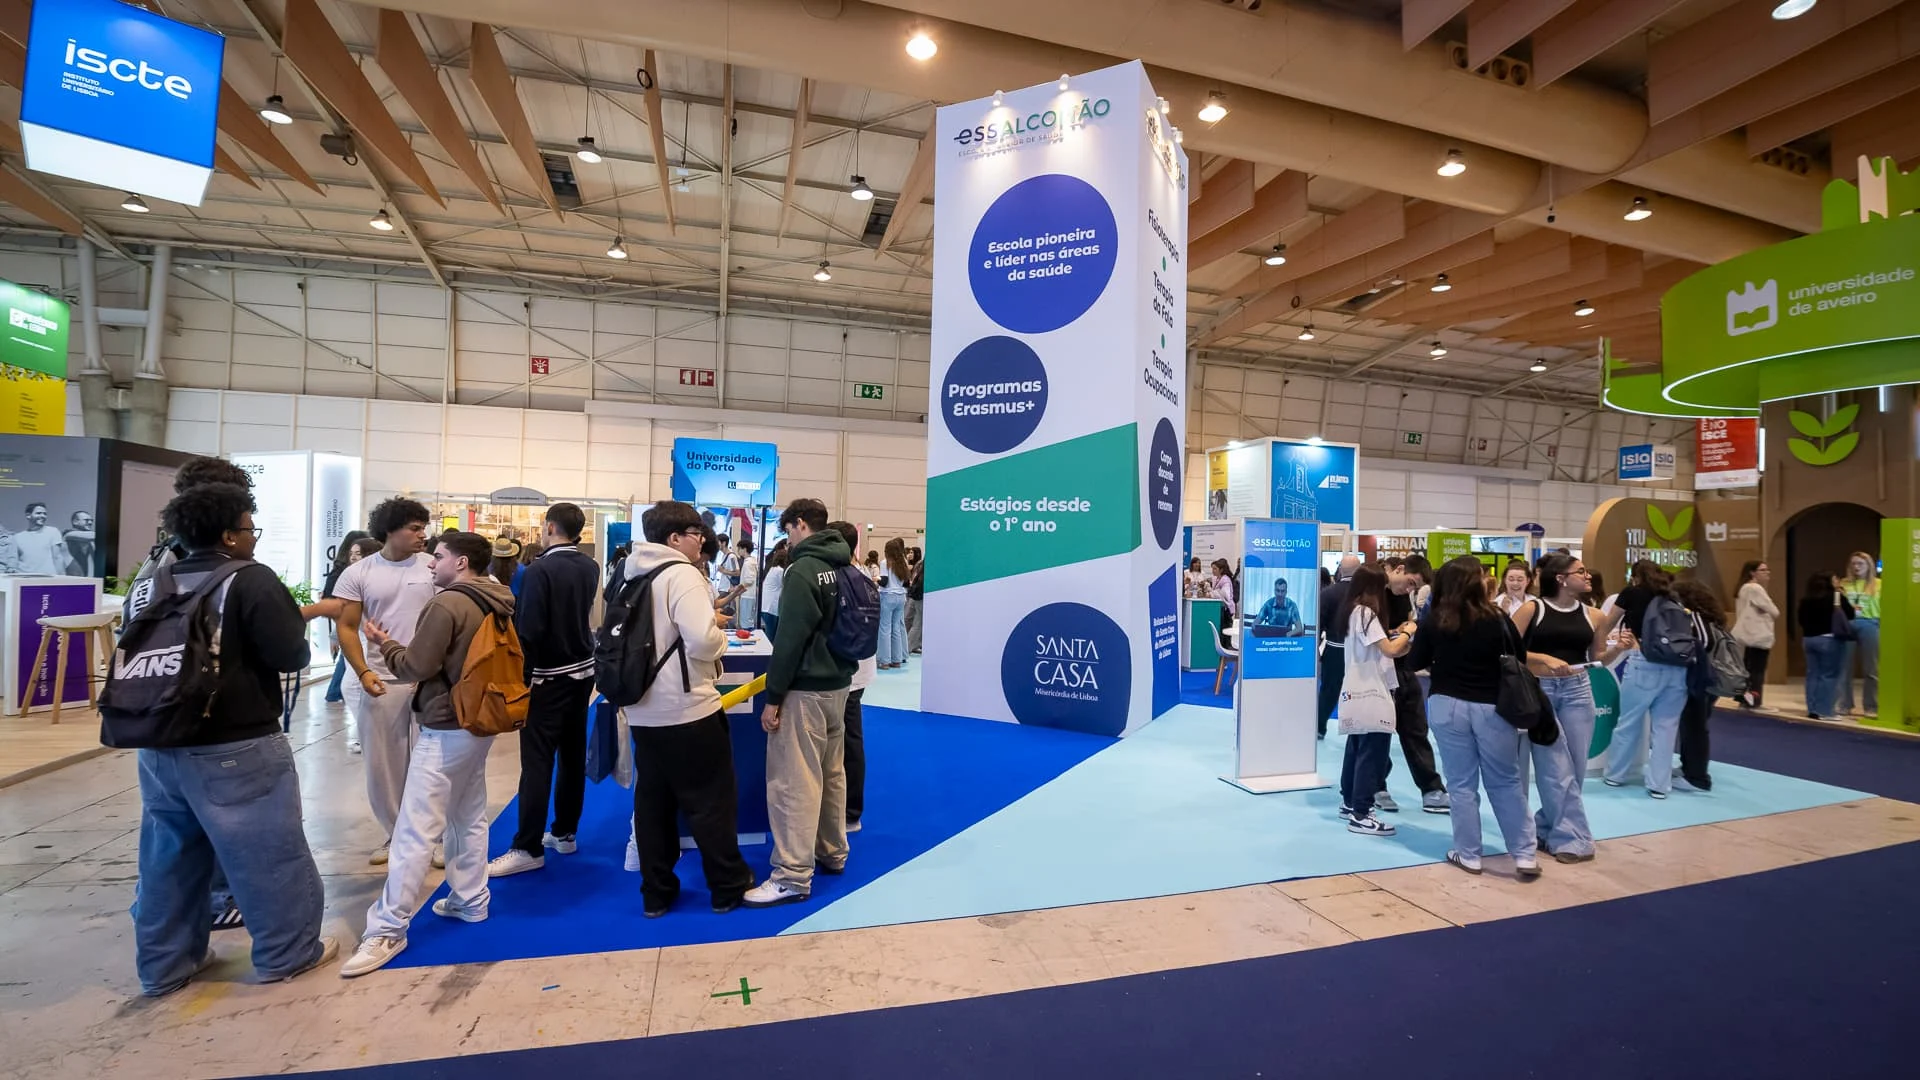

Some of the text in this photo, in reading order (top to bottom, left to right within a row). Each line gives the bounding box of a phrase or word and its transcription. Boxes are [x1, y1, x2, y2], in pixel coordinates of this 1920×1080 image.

[63, 71, 100, 86] INSTITUTO
[64, 38, 192, 100] iscte
[61, 83, 99, 97] DE LISBOA
[988, 227, 1096, 253] Escola pioneira
[1148, 208, 1180, 264] Fisioterapia
[983, 244, 1100, 269] e líder nas áreas
[1007, 263, 1073, 281] da saúde
[1788, 267, 1915, 301] universidade
[1153, 271, 1174, 306] Terapia
[1153, 297, 1174, 329] da Fala
[1788, 291, 1877, 316] de aveiro
[1152, 350, 1173, 381] Terapia
[948, 379, 1042, 399] Programas
[1144, 367, 1179, 407] Ocupacional
[953, 400, 1035, 417] Erasmus+
[1701, 429, 1728, 441] ISCE
[686, 450, 762, 464] Universidade
[686, 461, 735, 472] do Porto
[960, 496, 1091, 515] Estágios desde
[989, 520, 1001, 532] o
[1022, 519, 1057, 532] ano
[1036, 634, 1099, 660] SANTA
[114, 643, 186, 680] VANS
[1034, 660, 1099, 690] CASA
[1035, 687, 1099, 702] Misericórdia de Lisboa
